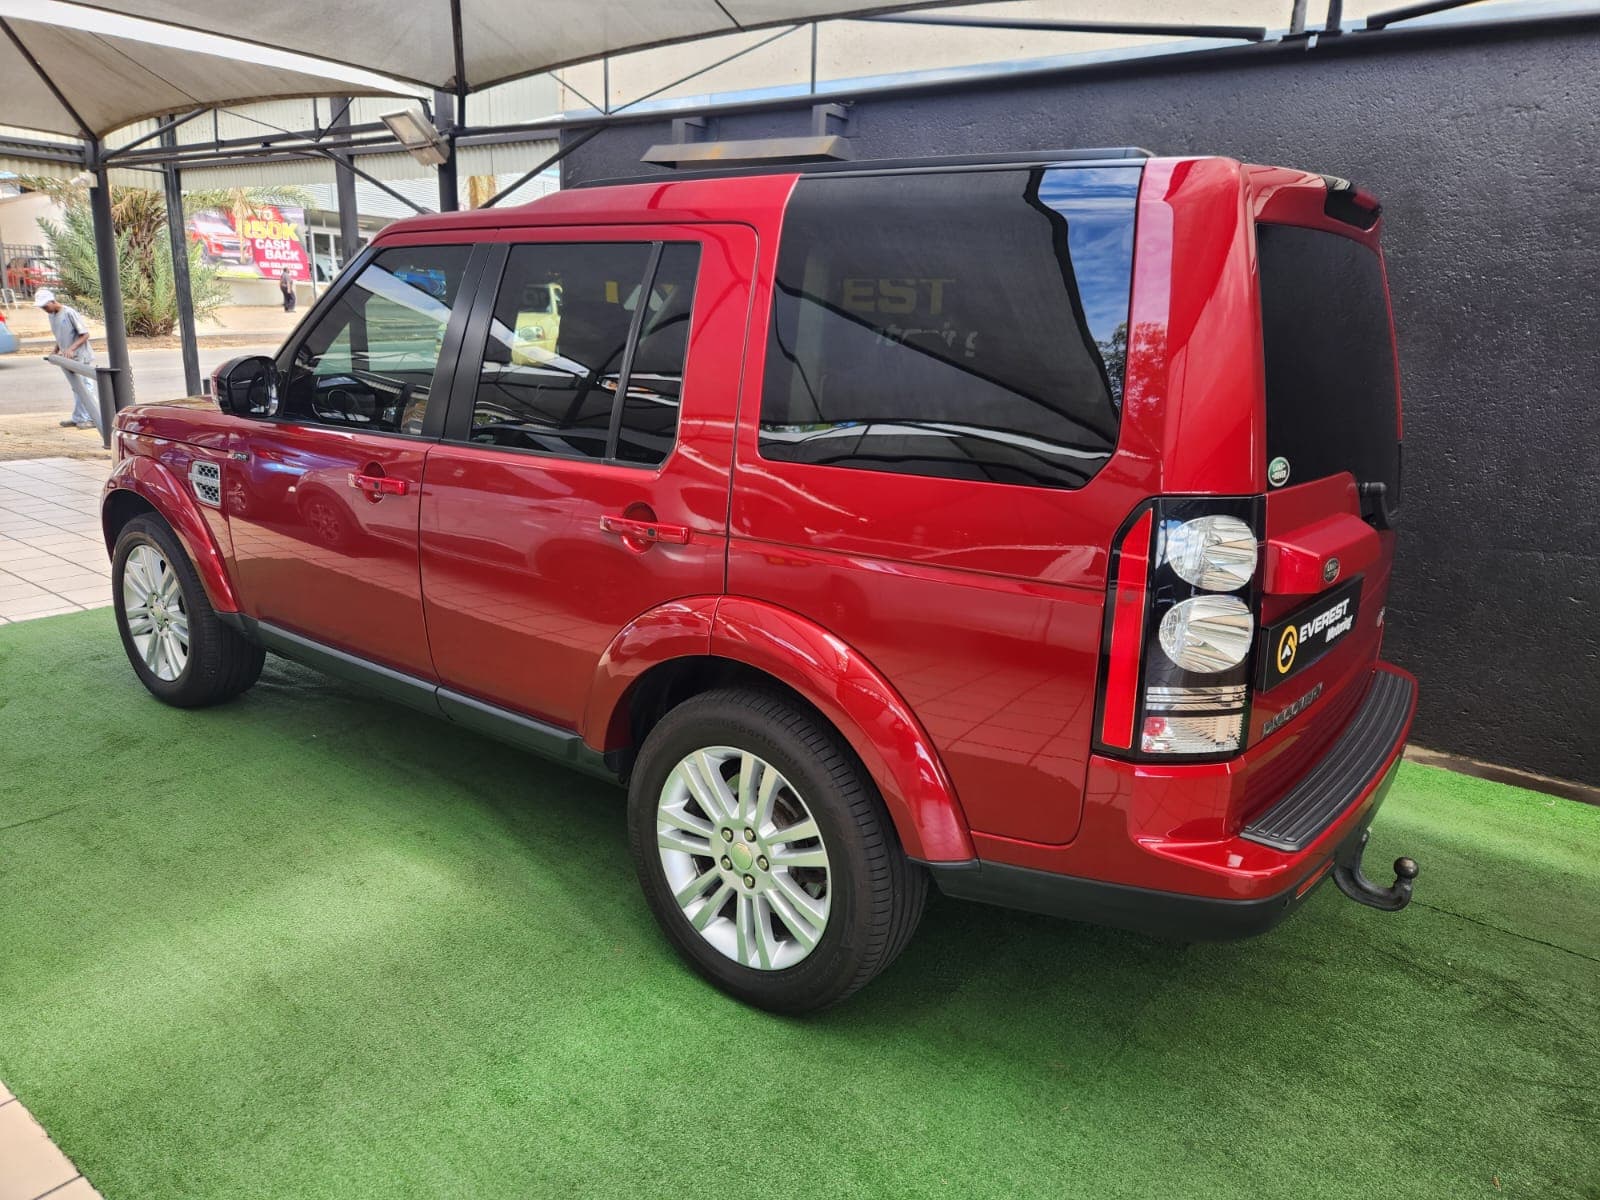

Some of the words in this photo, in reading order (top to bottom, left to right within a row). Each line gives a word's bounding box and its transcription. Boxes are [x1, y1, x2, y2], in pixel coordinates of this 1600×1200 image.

[255, 239, 290, 250] CASH
[265, 249, 300, 261] BACK
[1299, 598, 1350, 644] EVEREST
